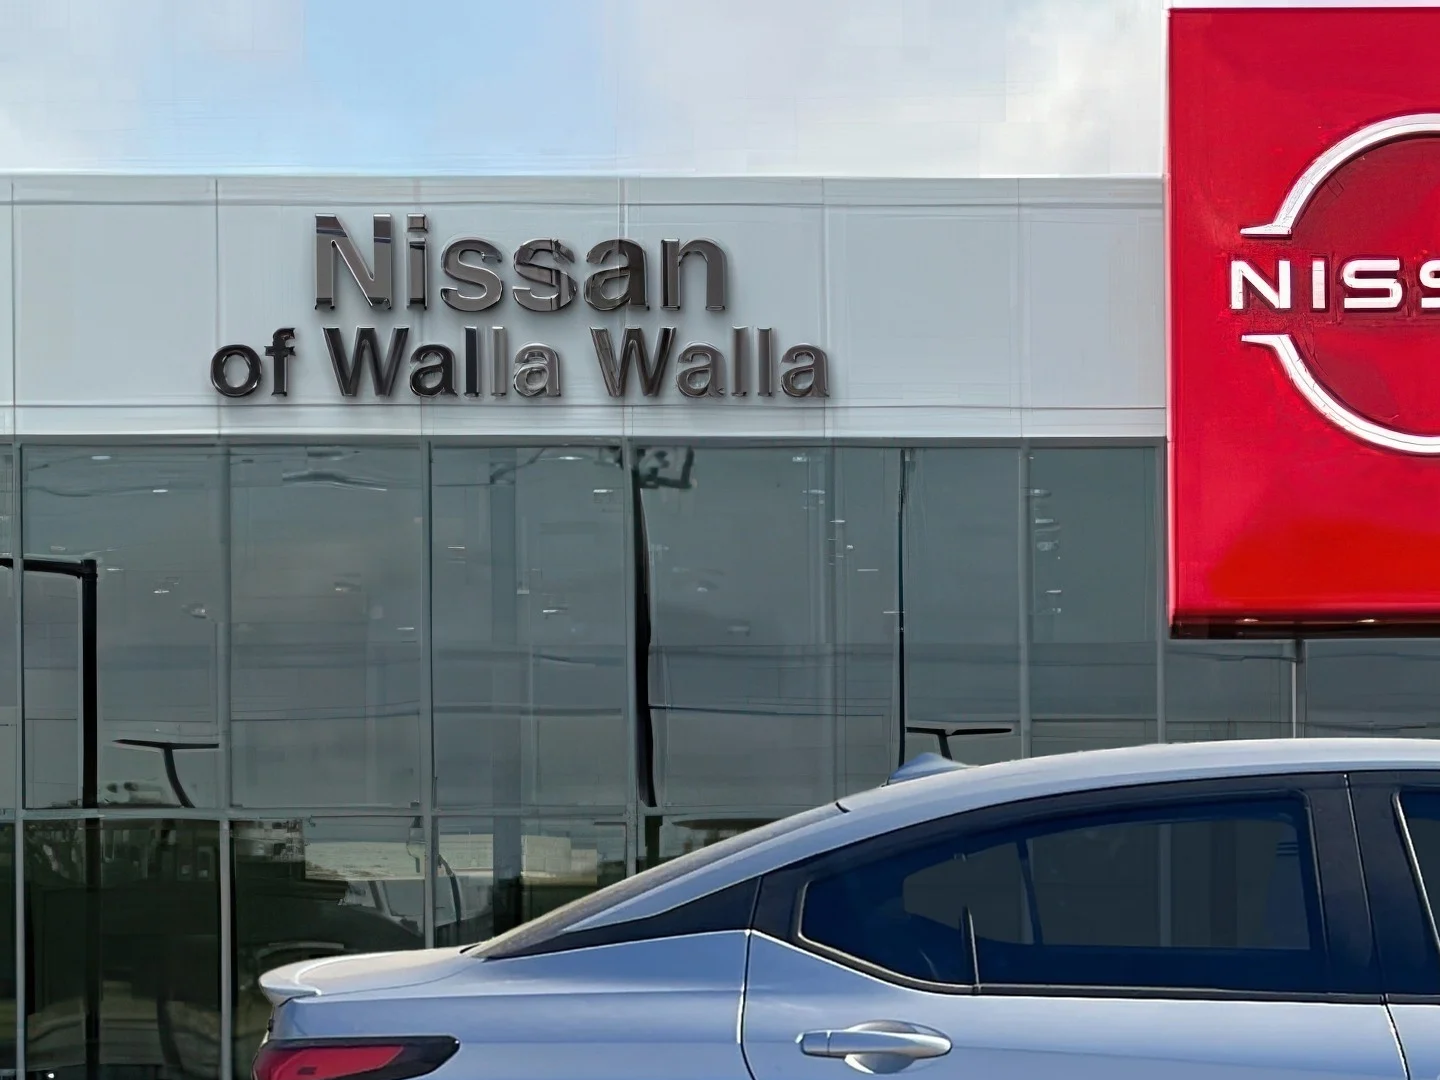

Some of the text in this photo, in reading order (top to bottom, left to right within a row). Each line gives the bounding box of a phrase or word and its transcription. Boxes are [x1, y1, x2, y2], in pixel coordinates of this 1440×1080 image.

[314, 213, 727, 311] Nissan
[210, 326, 830, 398] of Walla Walla
